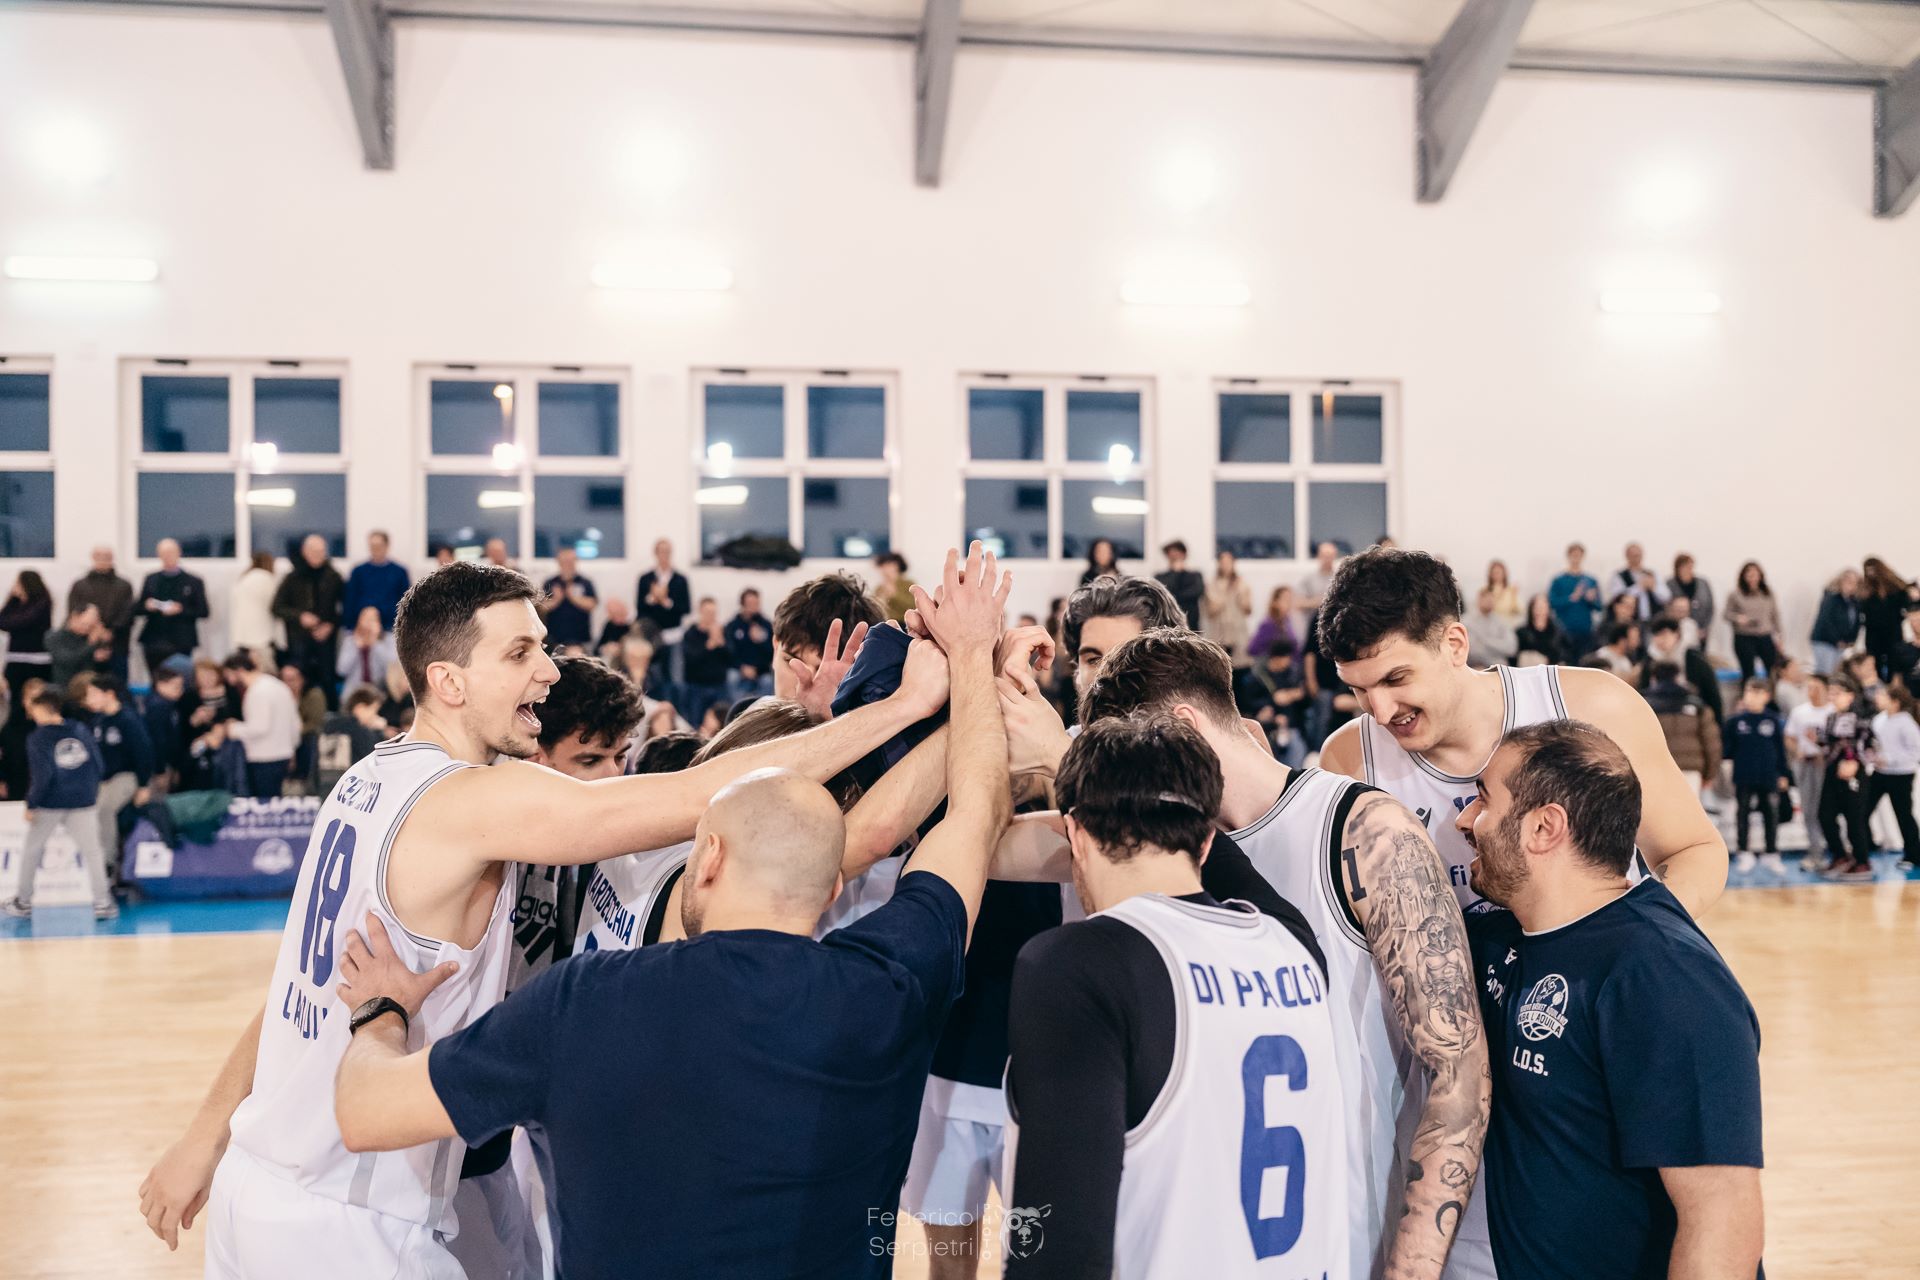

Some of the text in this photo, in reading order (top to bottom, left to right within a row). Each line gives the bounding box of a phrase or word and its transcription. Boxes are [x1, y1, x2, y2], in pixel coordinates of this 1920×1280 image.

[299, 818, 357, 988] 18
[1188, 962, 1225, 1005] DI
[1512, 1045, 1549, 1077] L.D.S.
[1240, 1034, 1308, 1261] 6
